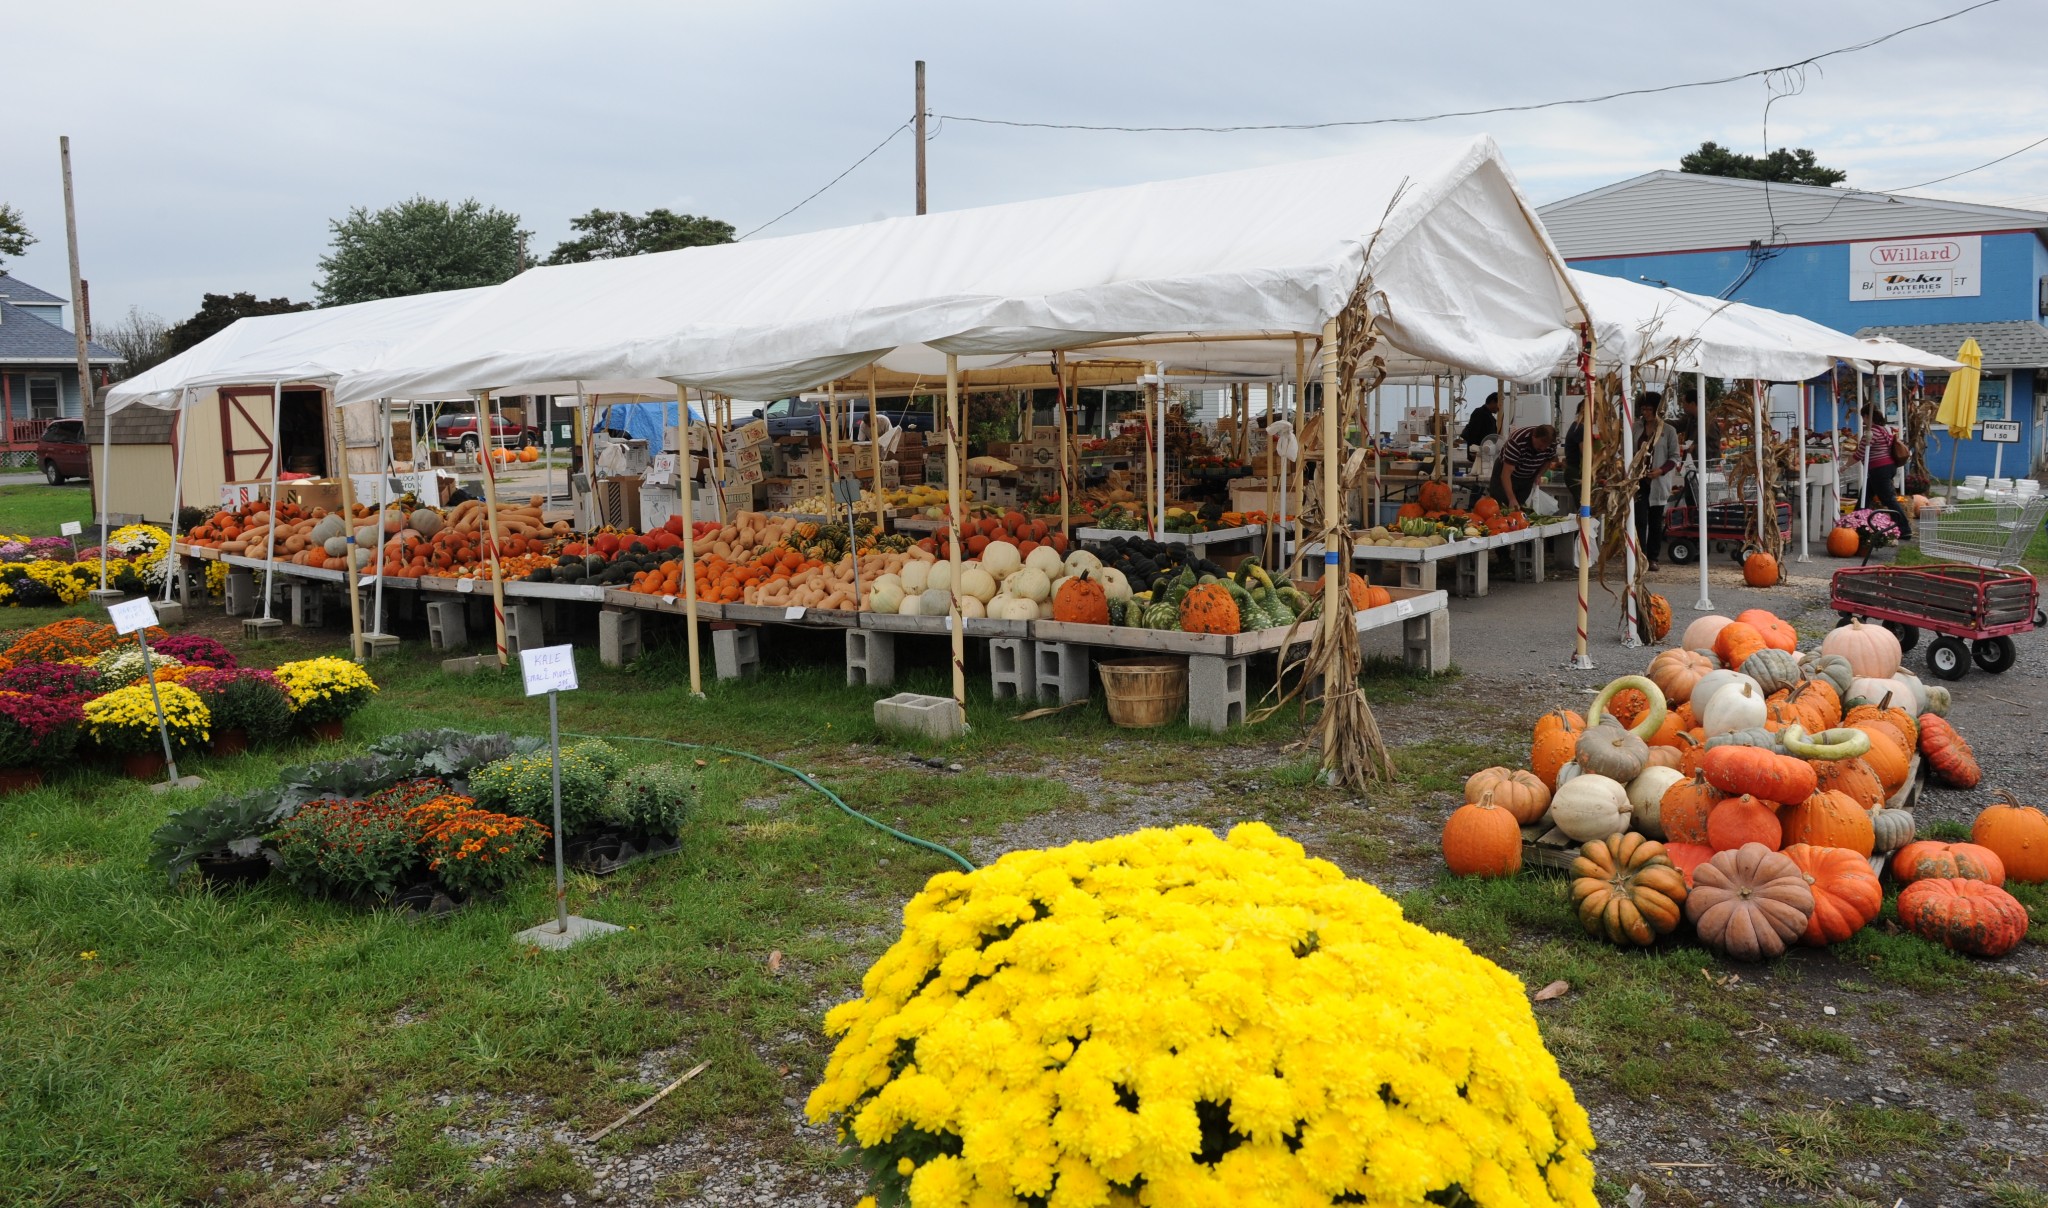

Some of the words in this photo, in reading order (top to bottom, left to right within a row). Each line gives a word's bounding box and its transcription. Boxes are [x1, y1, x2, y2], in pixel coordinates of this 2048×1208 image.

[1880, 246, 1950, 262] Willard
[1886, 274, 1942, 284] Deka
[1886, 283, 1942, 292] BATTERIES
[1985, 423, 2017, 431] BUCKETS
[534, 652, 561, 667] KALE
